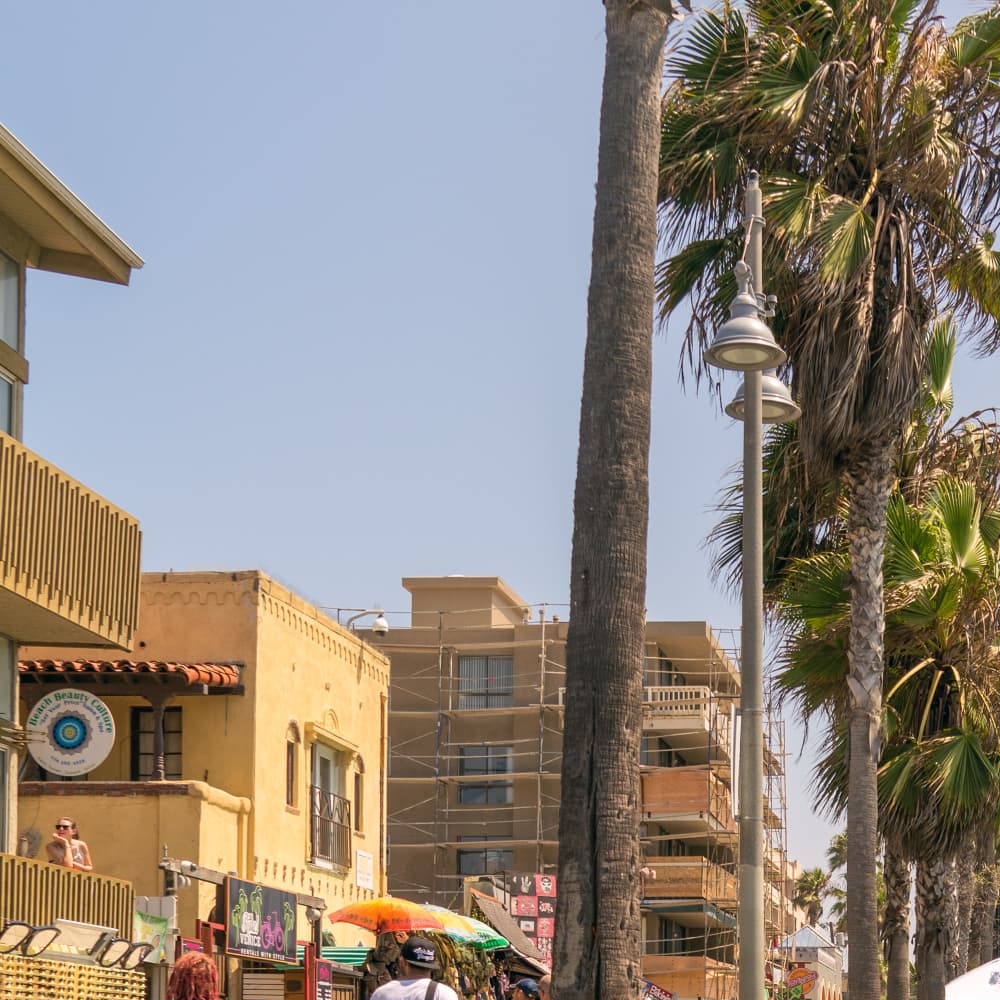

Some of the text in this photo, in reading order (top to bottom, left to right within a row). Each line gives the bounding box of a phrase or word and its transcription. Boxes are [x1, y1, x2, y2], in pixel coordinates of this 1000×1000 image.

[28, 698, 53, 726] Beach
[54, 692, 89, 702] Beauty
[91, 699, 112, 733] Culture
[240, 932, 261, 947] VENICE
[240, 948, 260, 957] RENTALS
